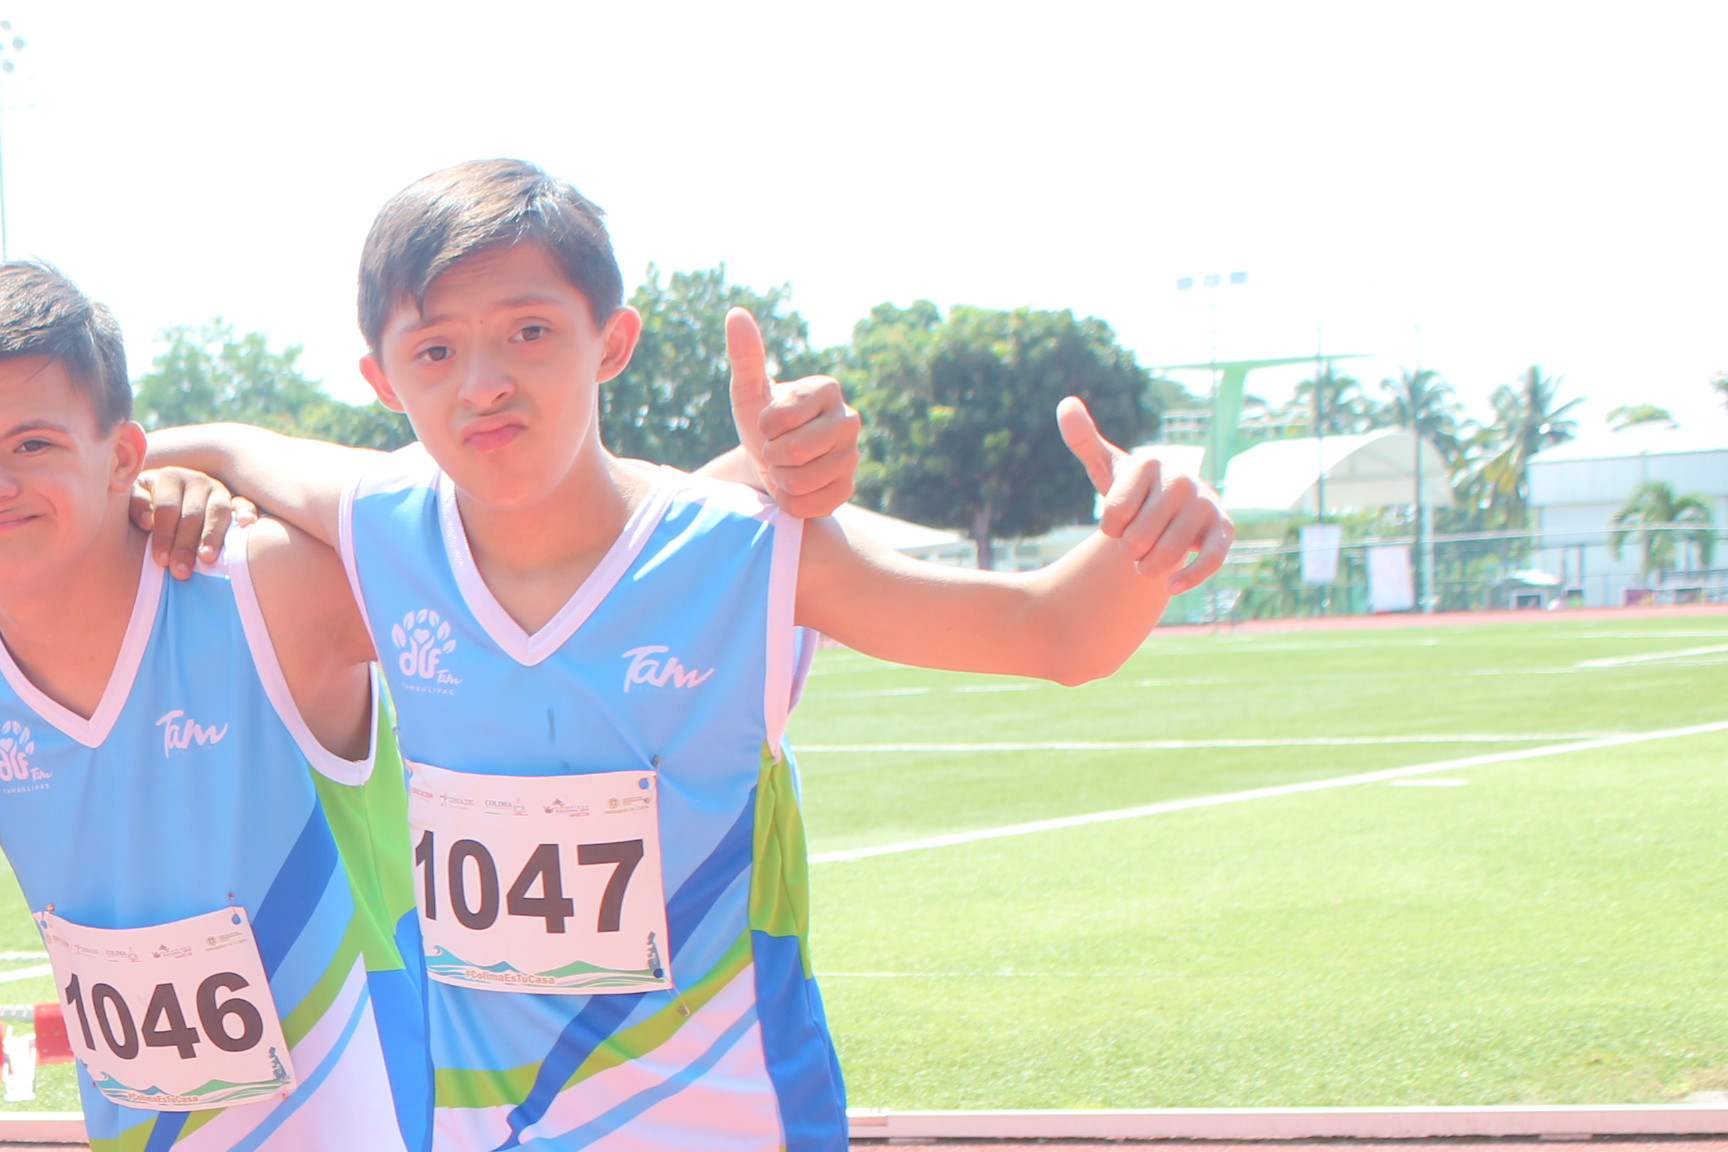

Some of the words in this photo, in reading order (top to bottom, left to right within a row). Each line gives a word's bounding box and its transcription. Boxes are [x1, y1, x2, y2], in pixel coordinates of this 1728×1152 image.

[621, 645, 715, 693] Tam
[155, 709, 229, 758] Tam
[415, 830, 644, 934] 1047
[465, 969, 556, 985] #ColimaEsTuCasa
[65, 972, 264, 1063] 1046
